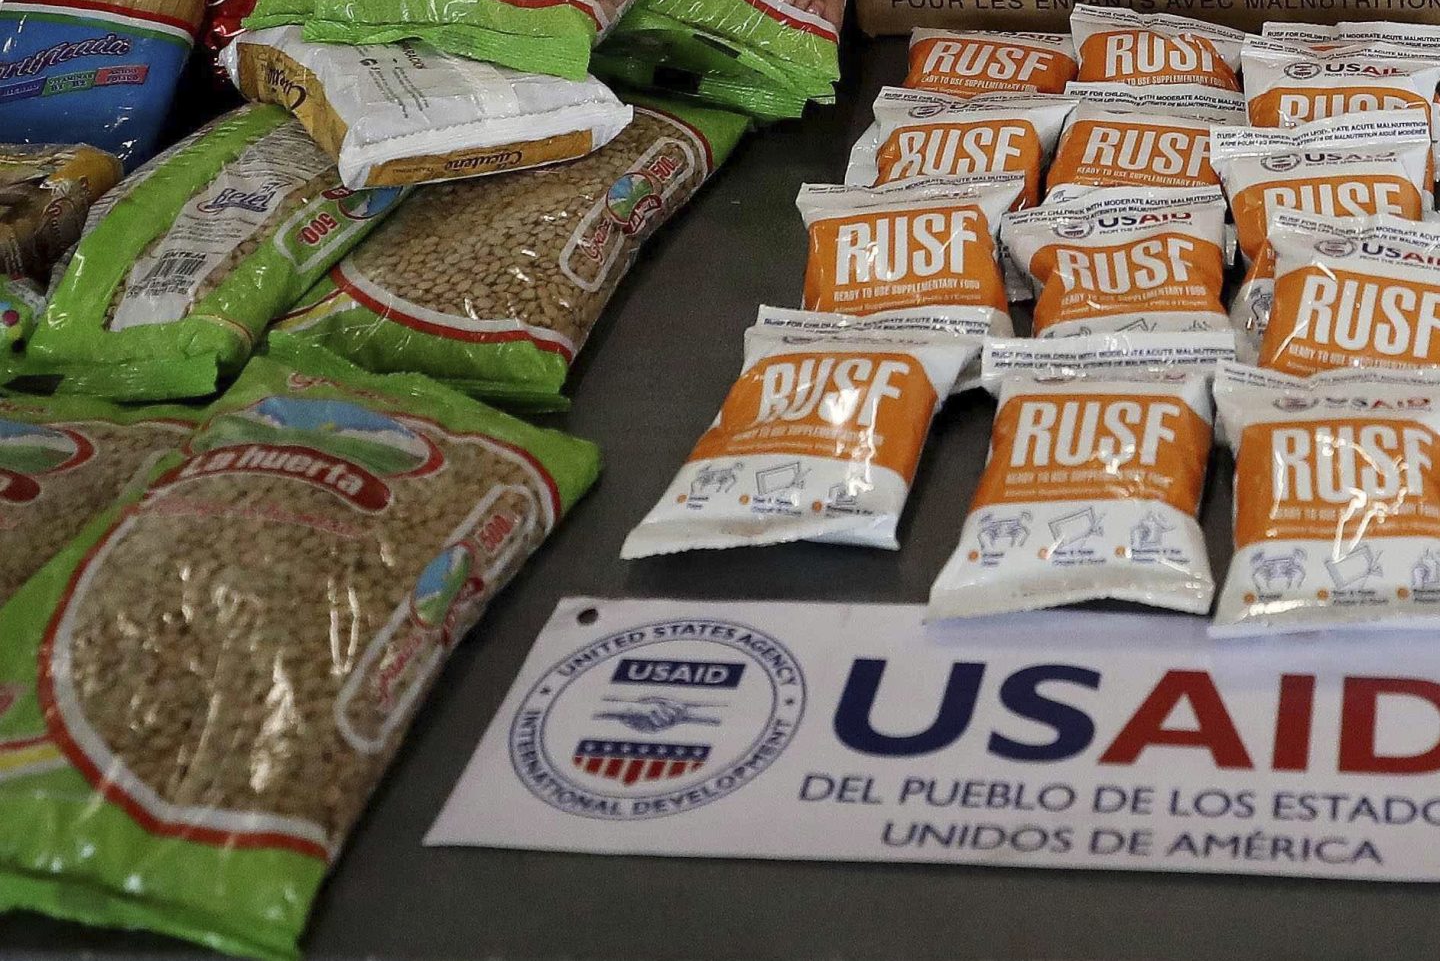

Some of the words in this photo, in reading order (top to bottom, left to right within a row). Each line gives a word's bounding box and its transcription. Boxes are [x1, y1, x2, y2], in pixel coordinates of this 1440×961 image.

[923, 40, 1053, 82] RUSF
[833, 209, 980, 287] RUSF
[1055, 237, 1195, 296] RUSF
[754, 358, 910, 426] RUSF
[1010, 400, 1181, 467] RUSF
[179, 448, 231, 479] La
[237, 443, 364, 497] huerta
[1272, 425, 1433, 502] RUSF
[627, 663, 729, 684] USAID
[799, 773, 881, 804] DEL
[898, 776, 1077, 812] PUEBLO
[1092, 784, 1154, 815] DE
[1168, 789, 1256, 819] LOS
[880, 822, 1072, 853] UNIDOS
[1089, 828, 1152, 856] DE
[1166, 831, 1383, 865] AMÉRICA
